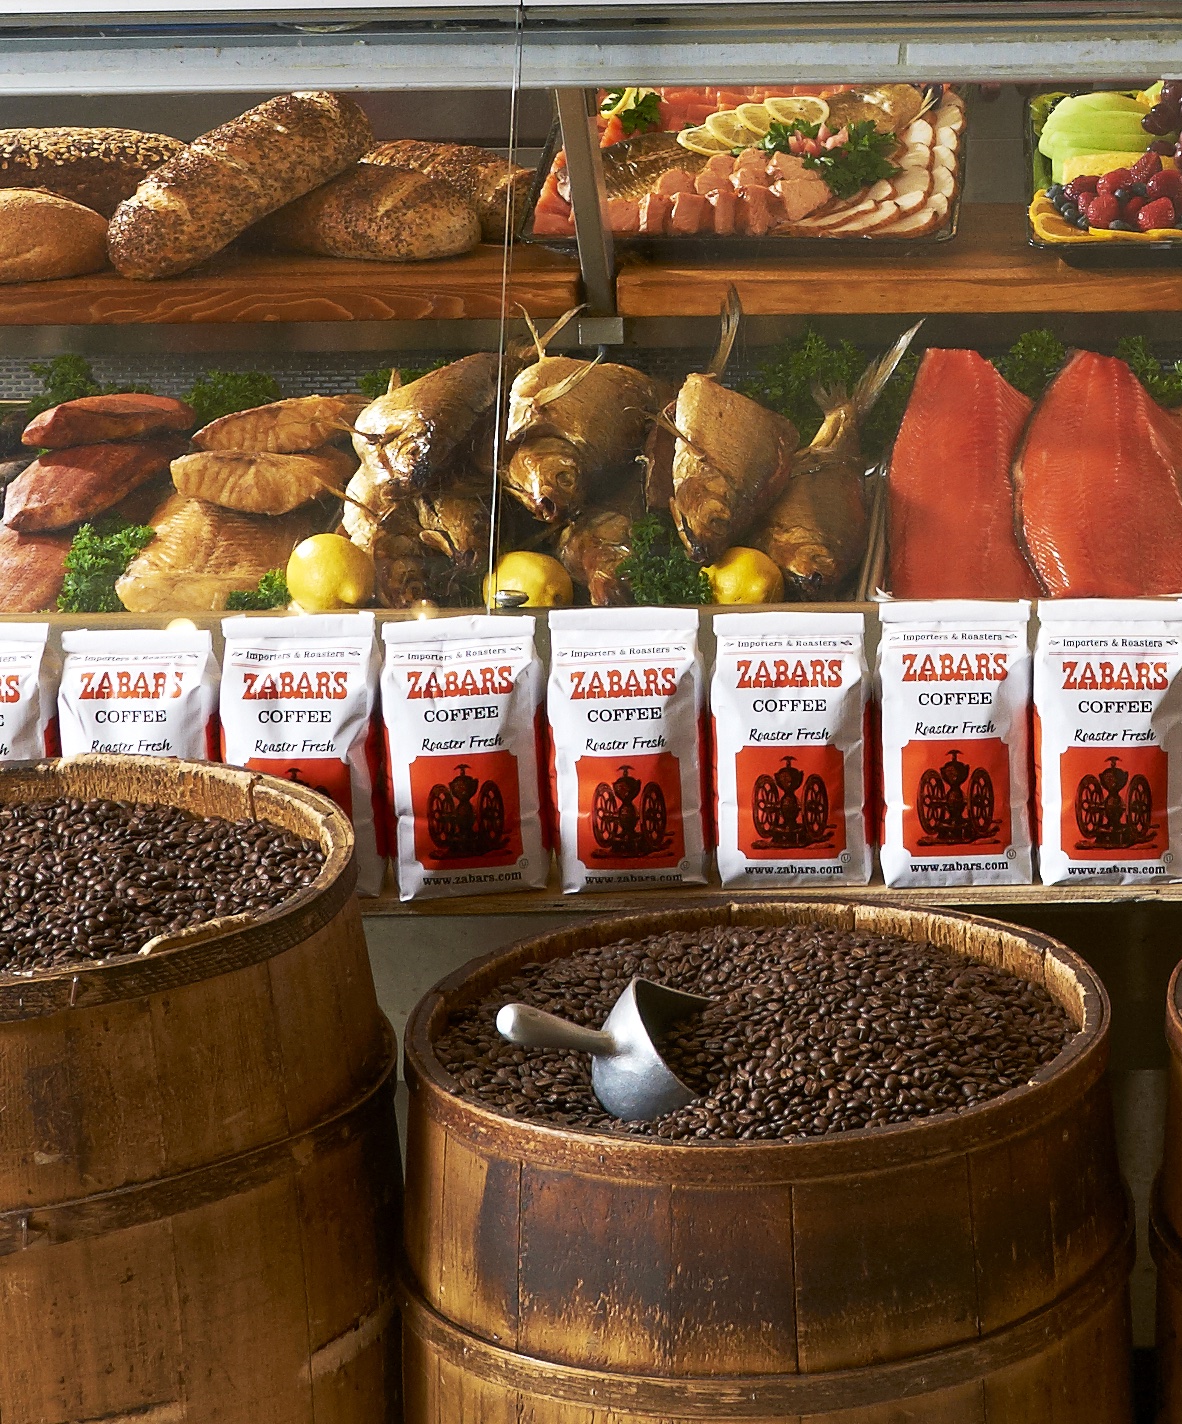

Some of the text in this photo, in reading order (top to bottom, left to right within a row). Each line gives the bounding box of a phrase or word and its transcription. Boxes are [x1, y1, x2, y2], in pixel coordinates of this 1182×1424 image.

[571, 649, 615, 658] Importers
[630, 645, 670, 655] Roasters
[918, 692, 992, 705] COFFEE
[258, 710, 331, 724] COFFEE
[424, 706, 499, 723] COFFEE
[588, 708, 662, 723] COFFEE
[255, 739, 336, 754] Roaster Fresh
[910, 860, 1008, 873] www.zabars.com
[423, 871, 522, 886] www.zabars.com
